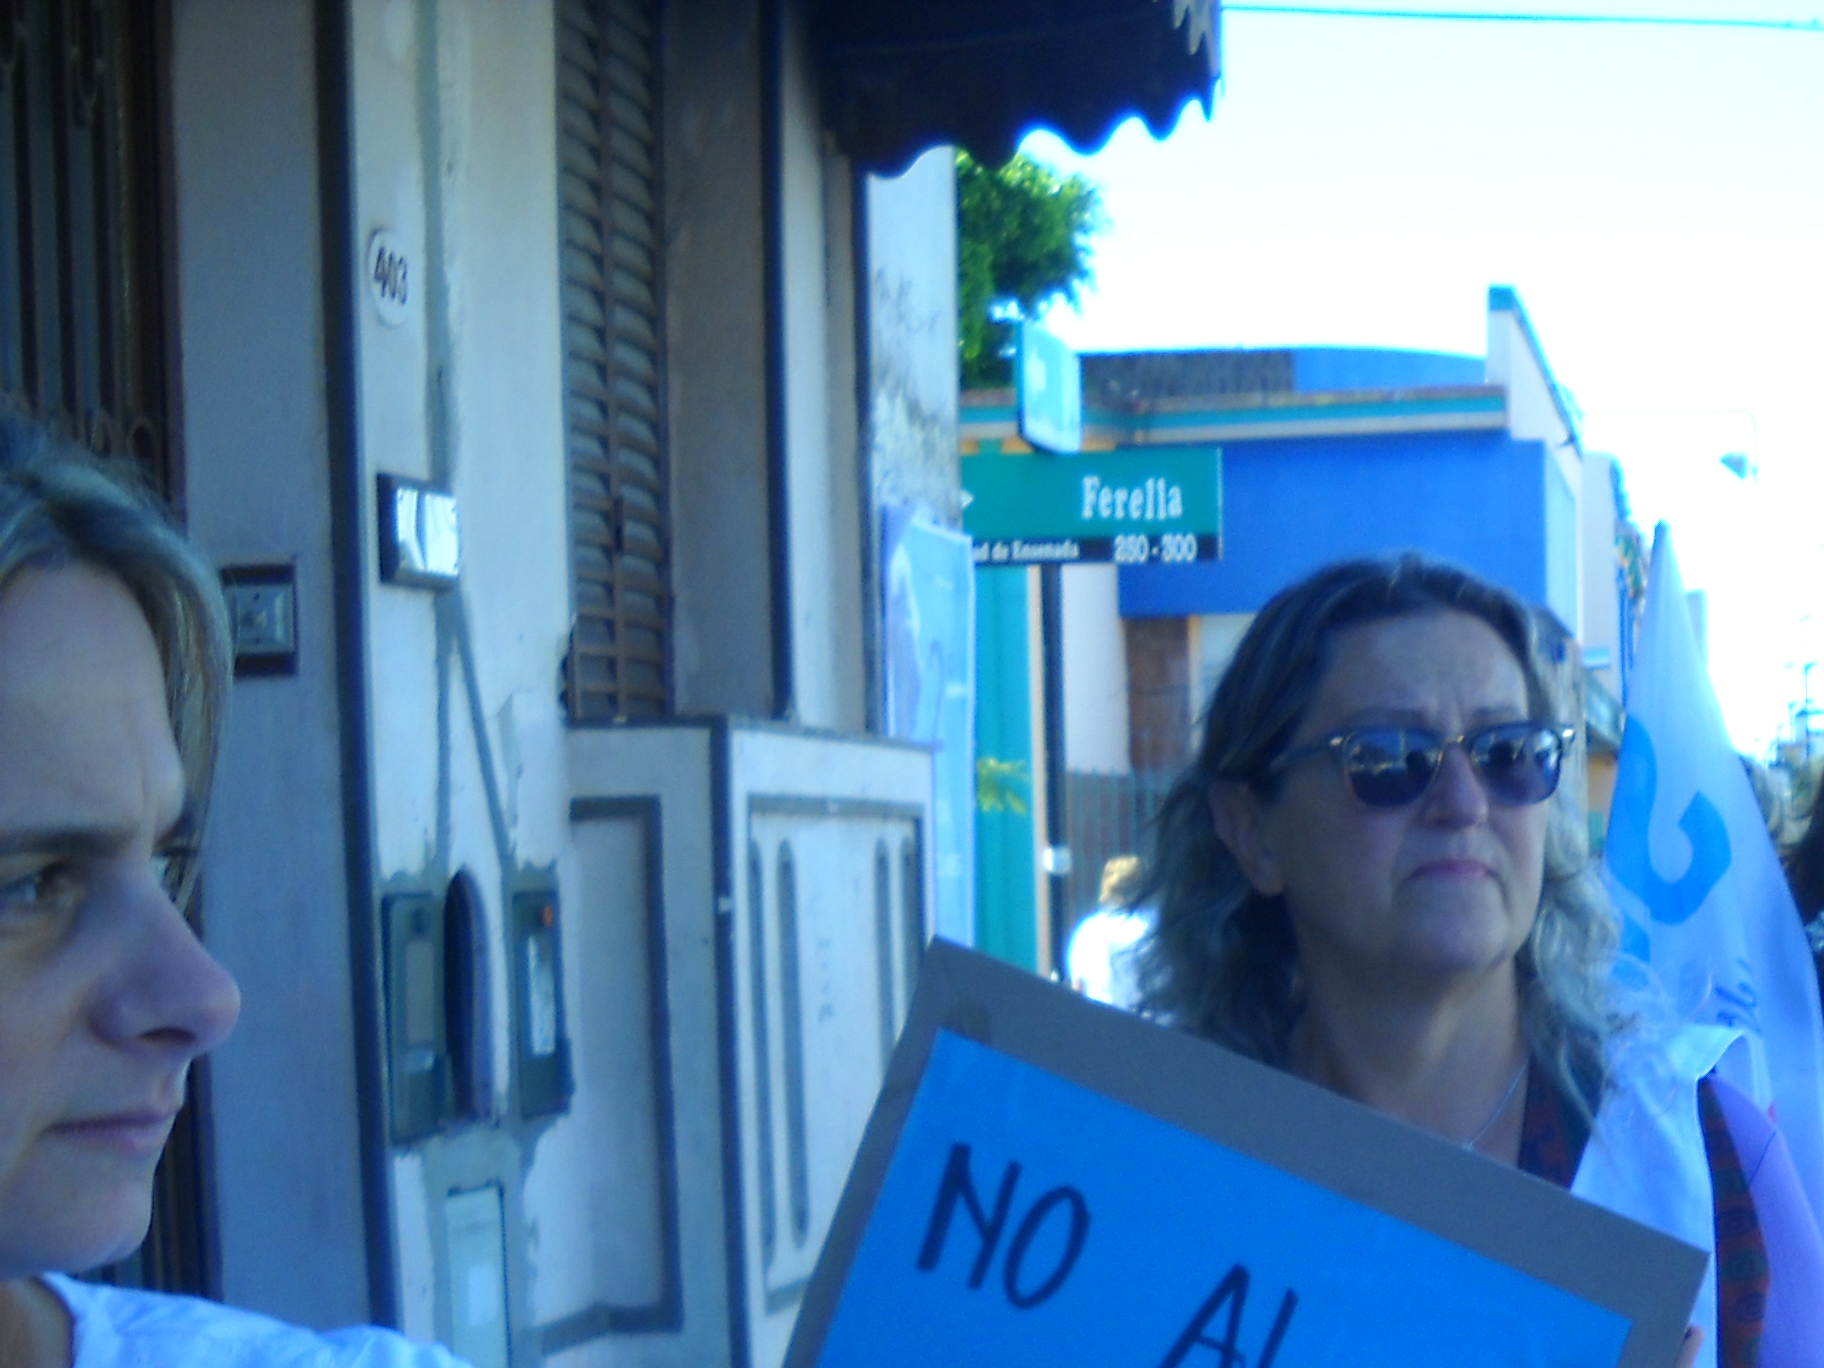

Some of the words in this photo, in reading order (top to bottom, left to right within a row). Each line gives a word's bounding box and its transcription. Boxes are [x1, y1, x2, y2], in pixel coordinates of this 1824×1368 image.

[373, 246, 408, 305] 403
[1081, 475, 1183, 520] Ferella
[917, 1140, 1090, 1310] NO
